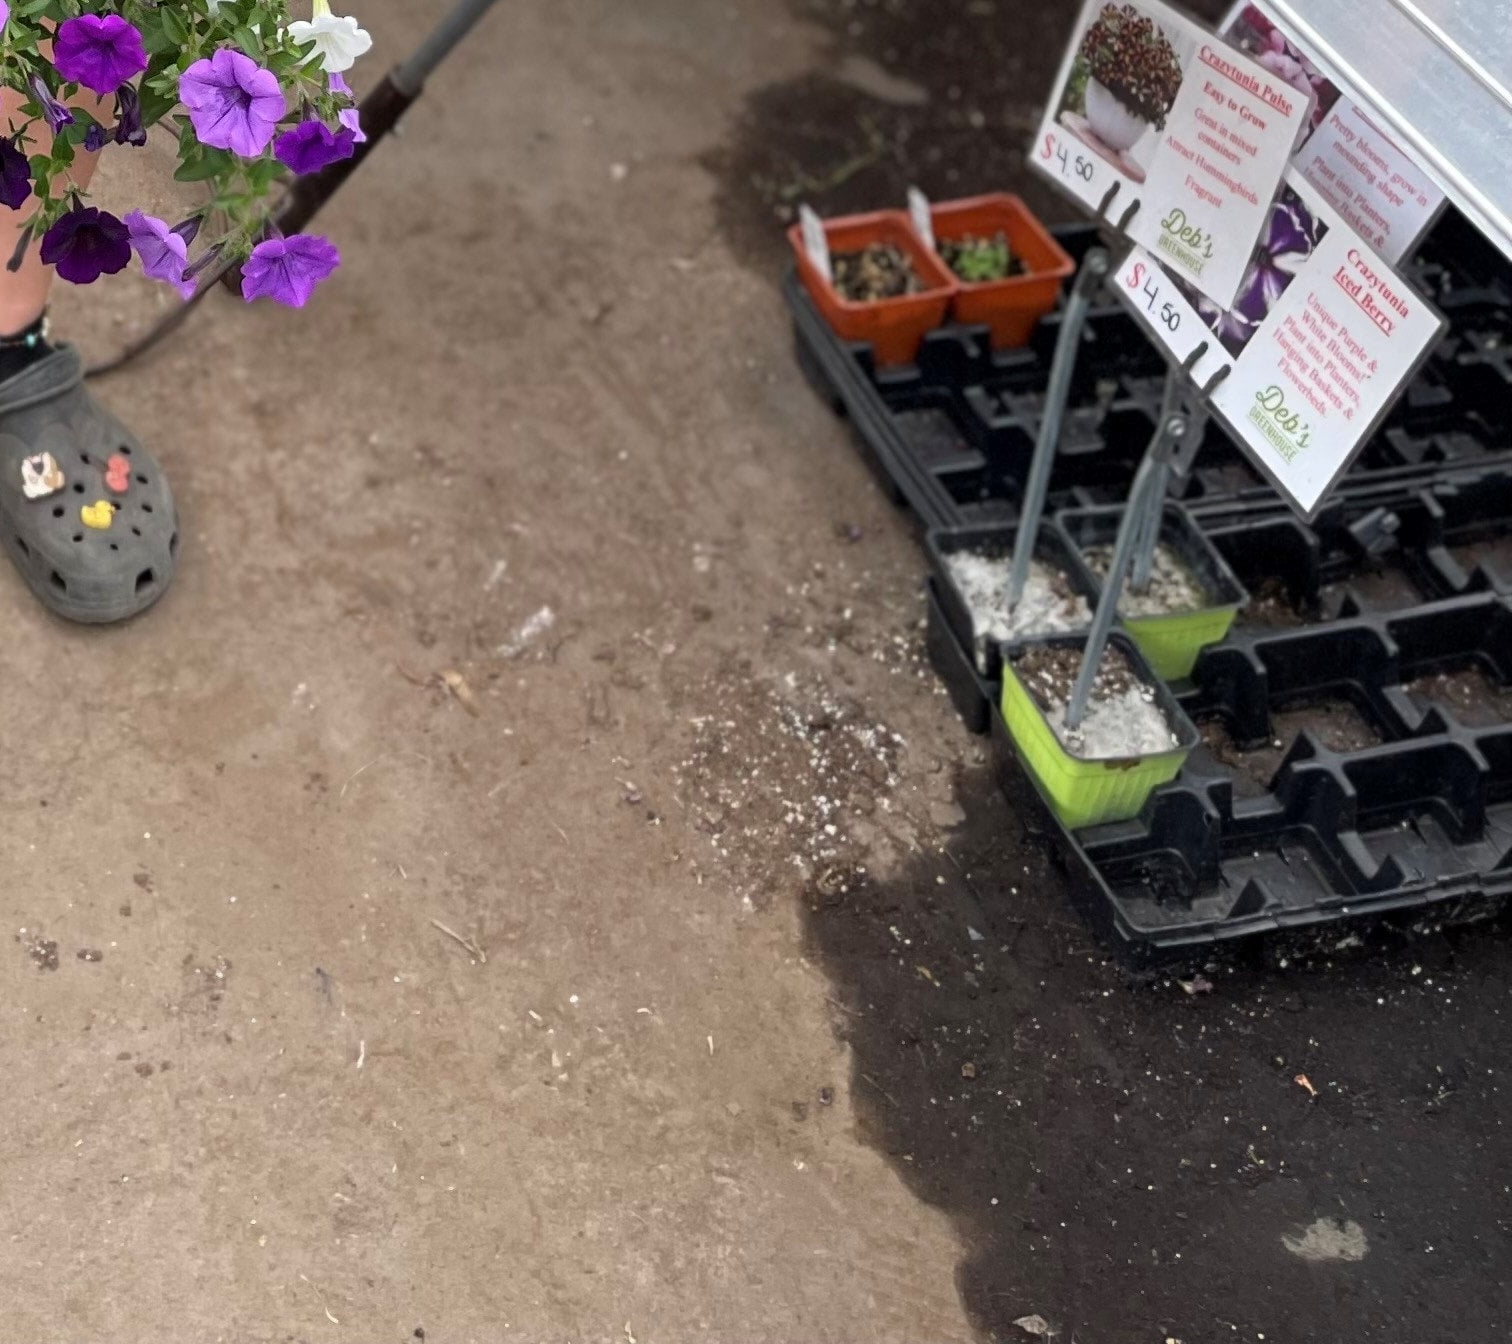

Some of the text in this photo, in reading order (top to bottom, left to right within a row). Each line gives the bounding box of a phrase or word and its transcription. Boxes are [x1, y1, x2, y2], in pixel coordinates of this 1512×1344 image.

[1200, 45, 1293, 112] Crazytunia Pulse
[1203, 81, 1267, 130] Easy to Grow
[1198, 132, 1240, 164] containers
[1219, 123, 1229, 137] in
[1230, 134, 1257, 156] mixed
[1330, 114, 1355, 143] Pretty
[1390, 172, 1416, 196] grow
[1416, 193, 1428, 207] in
[1185, 174, 1223, 207] Fragrant
[1195, 154, 1258, 204] Hummingbirds
[1313, 156, 1336, 180] Plant
[1335, 178, 1353, 197] into
[1333, 142, 1403, 206] mounding shape
[1161, 208, 1213, 258] Deb's
[1336, 266, 1395, 333] Iced Berry
[1347, 249, 1410, 318] Crazytunia
[1284, 315, 1306, 342] Plant
[1306, 342, 1324, 362] into
[1302, 309, 1327, 341] White
[1307, 292, 1378, 373] Unique Purple &
[1273, 328, 1353, 420] Hanging Baskets &
[1255, 385, 1309, 448] Deb's
